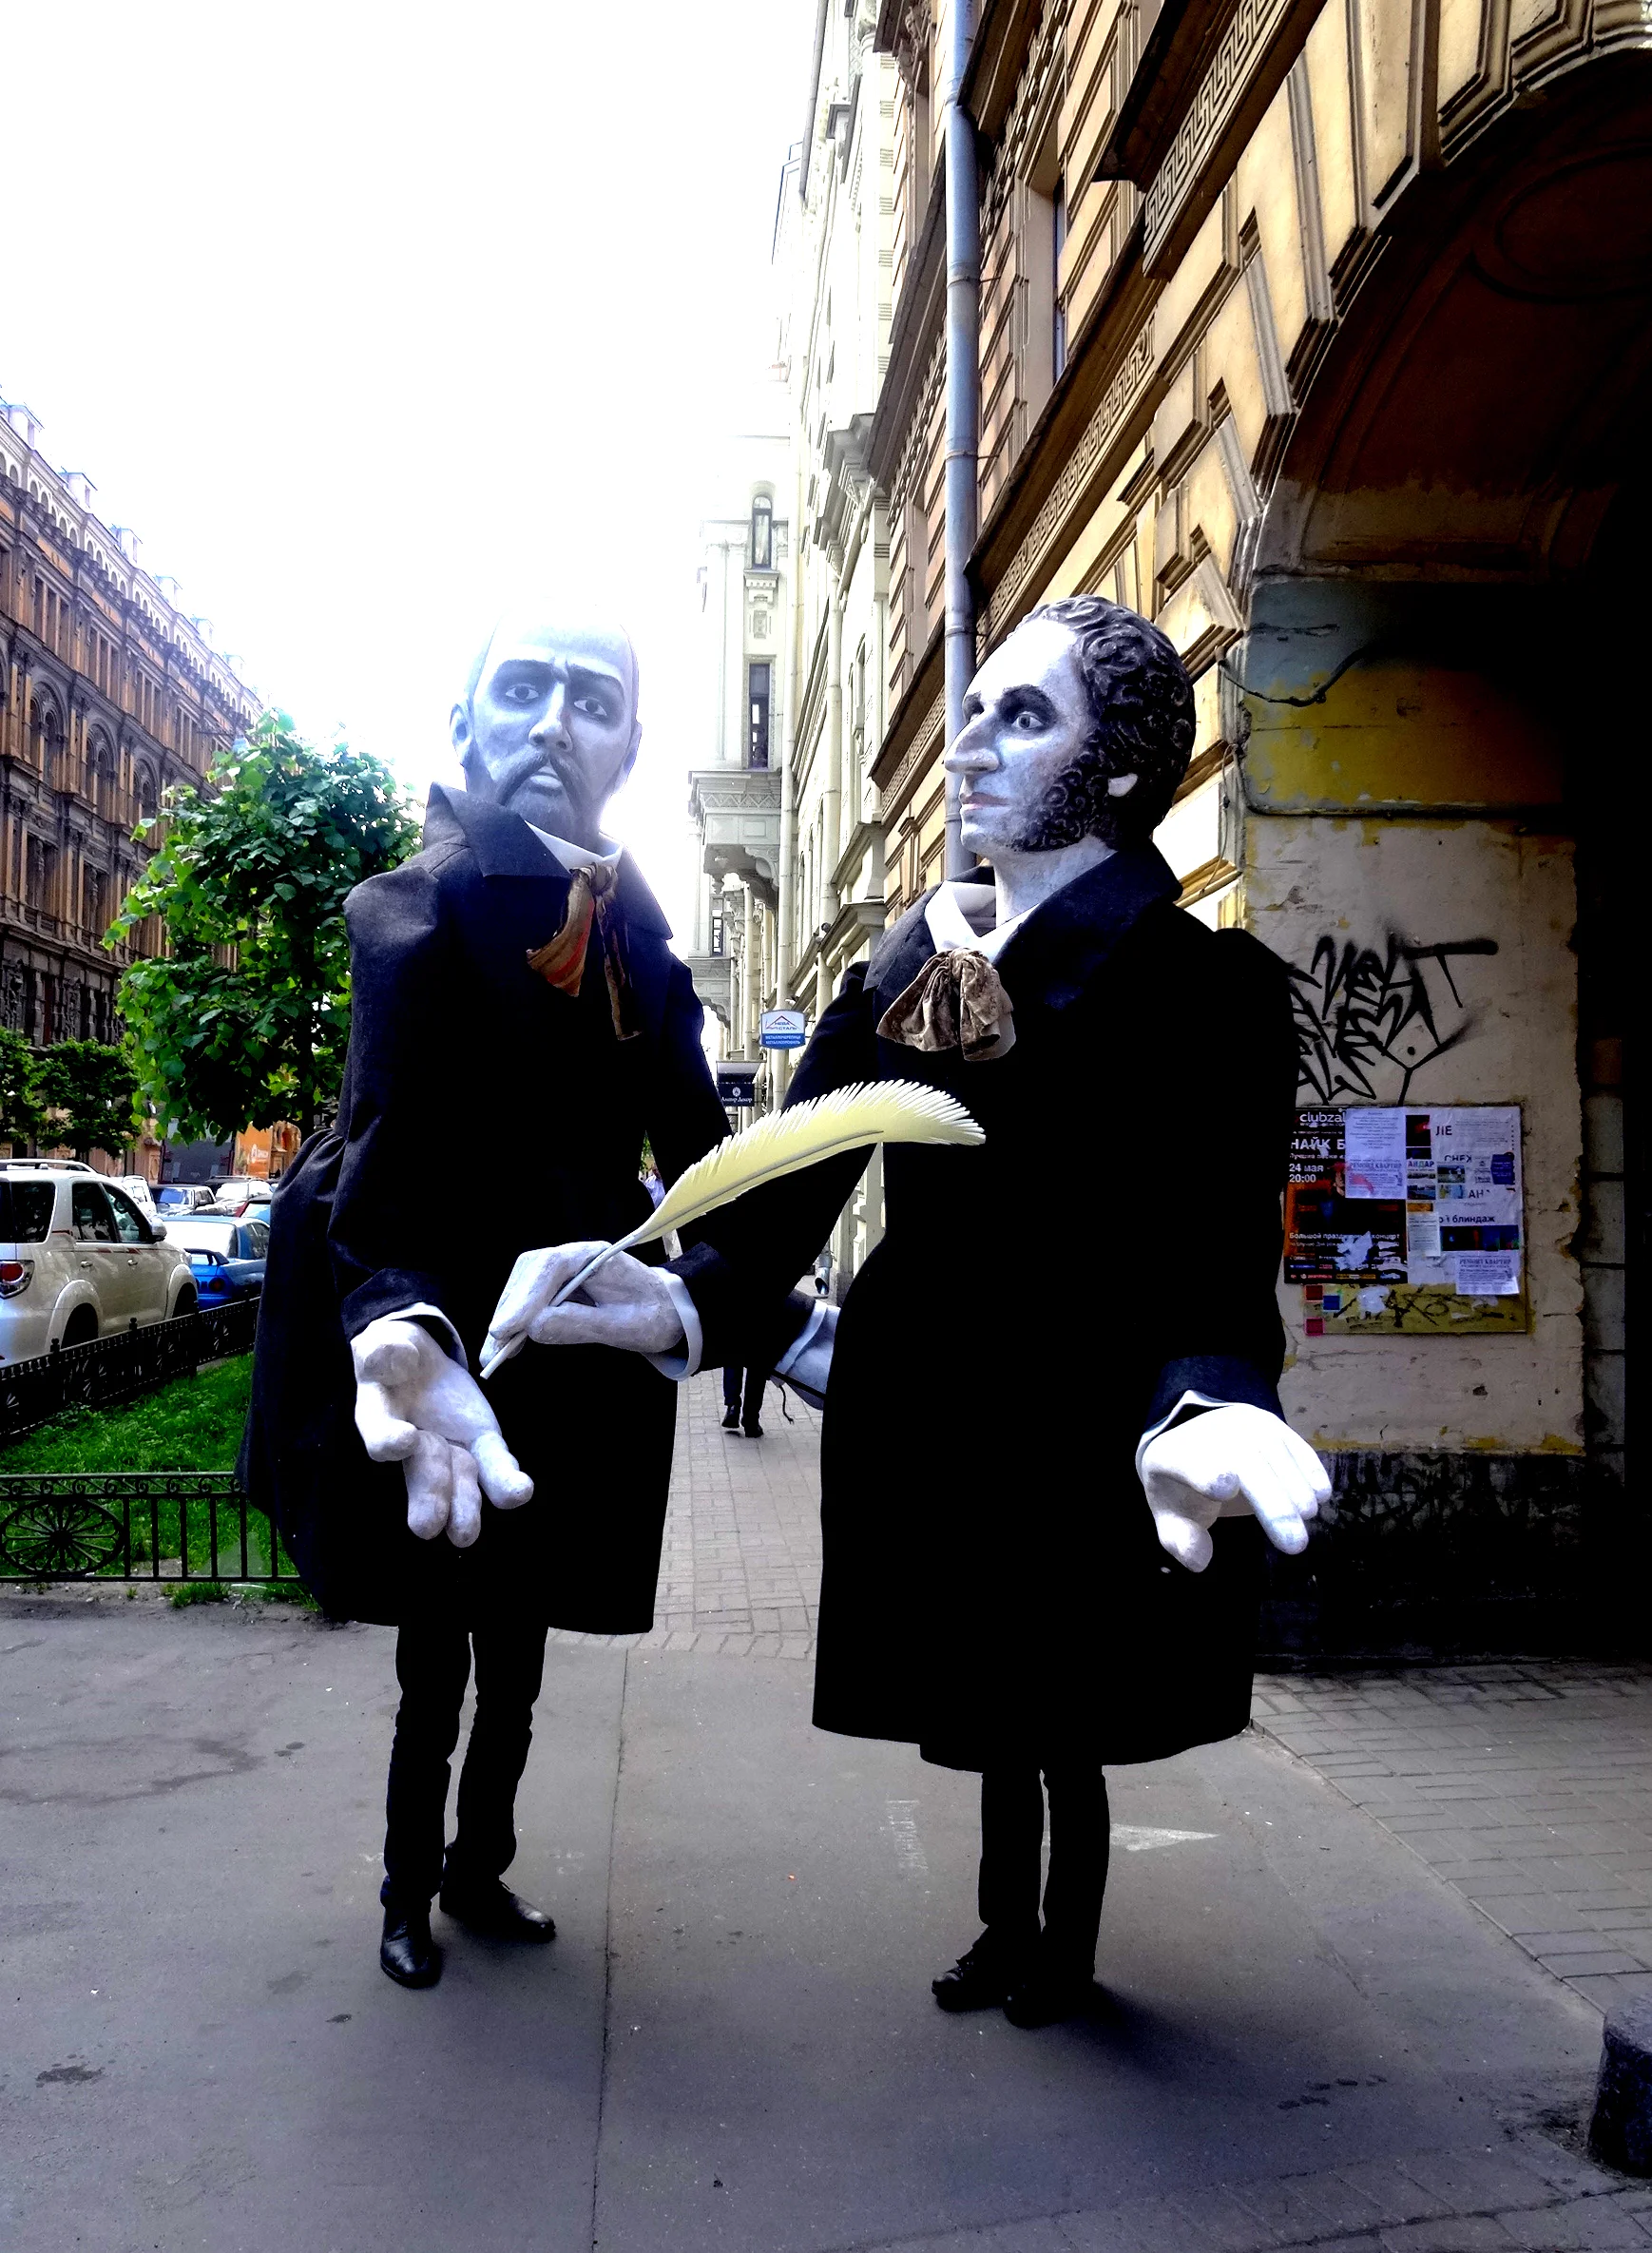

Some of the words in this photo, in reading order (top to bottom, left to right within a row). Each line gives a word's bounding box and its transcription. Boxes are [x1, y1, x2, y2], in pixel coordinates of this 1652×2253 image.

[1290, 1136, 1332, 1150] НАЙК
[1288, 1163, 1302, 1173] 24
[1303, 1165, 1325, 1173] мая
[1288, 1173, 1317, 1184] 20:00
[1451, 1214, 1495, 1223] блиндаж
